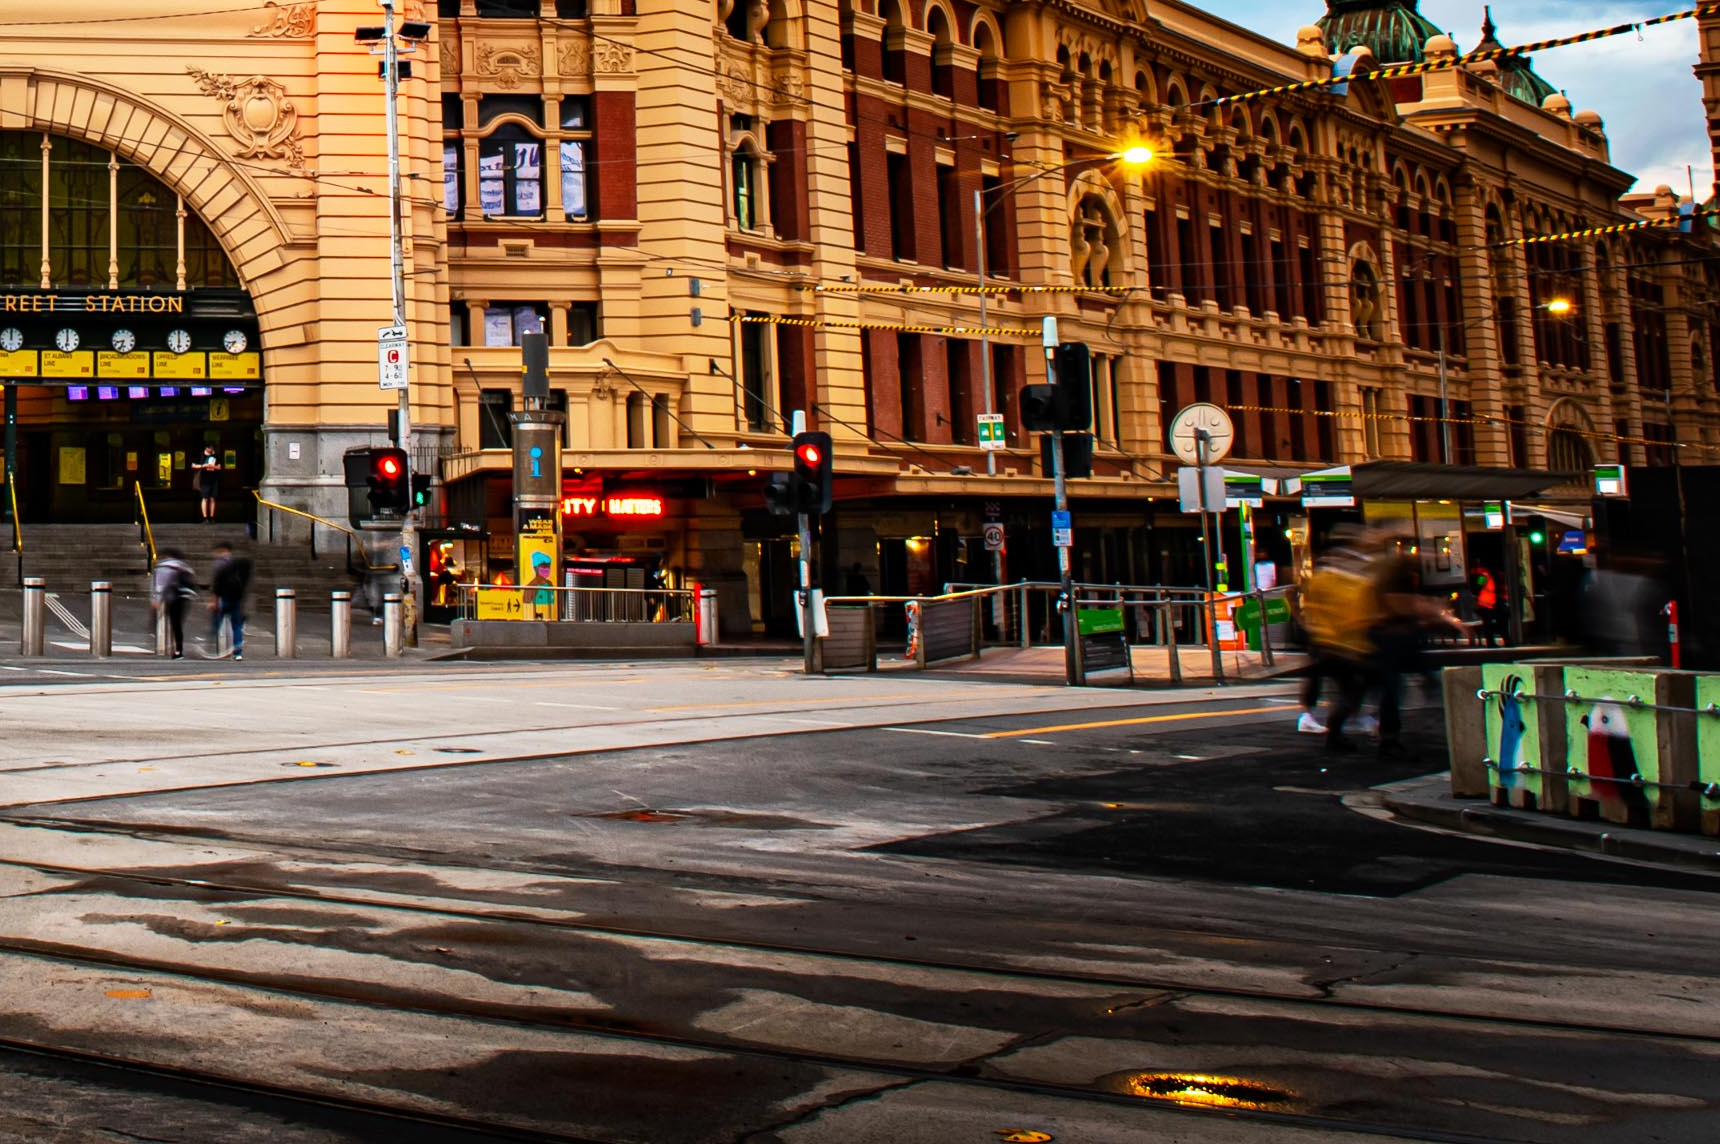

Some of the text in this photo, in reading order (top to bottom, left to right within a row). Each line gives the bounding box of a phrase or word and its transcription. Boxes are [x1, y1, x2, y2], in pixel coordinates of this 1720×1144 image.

[85, 295, 183, 313] STATION
[388, 350, 399, 363] C
[561, 498, 596, 515] ITY
[986, 531, 1000, 542] 40
